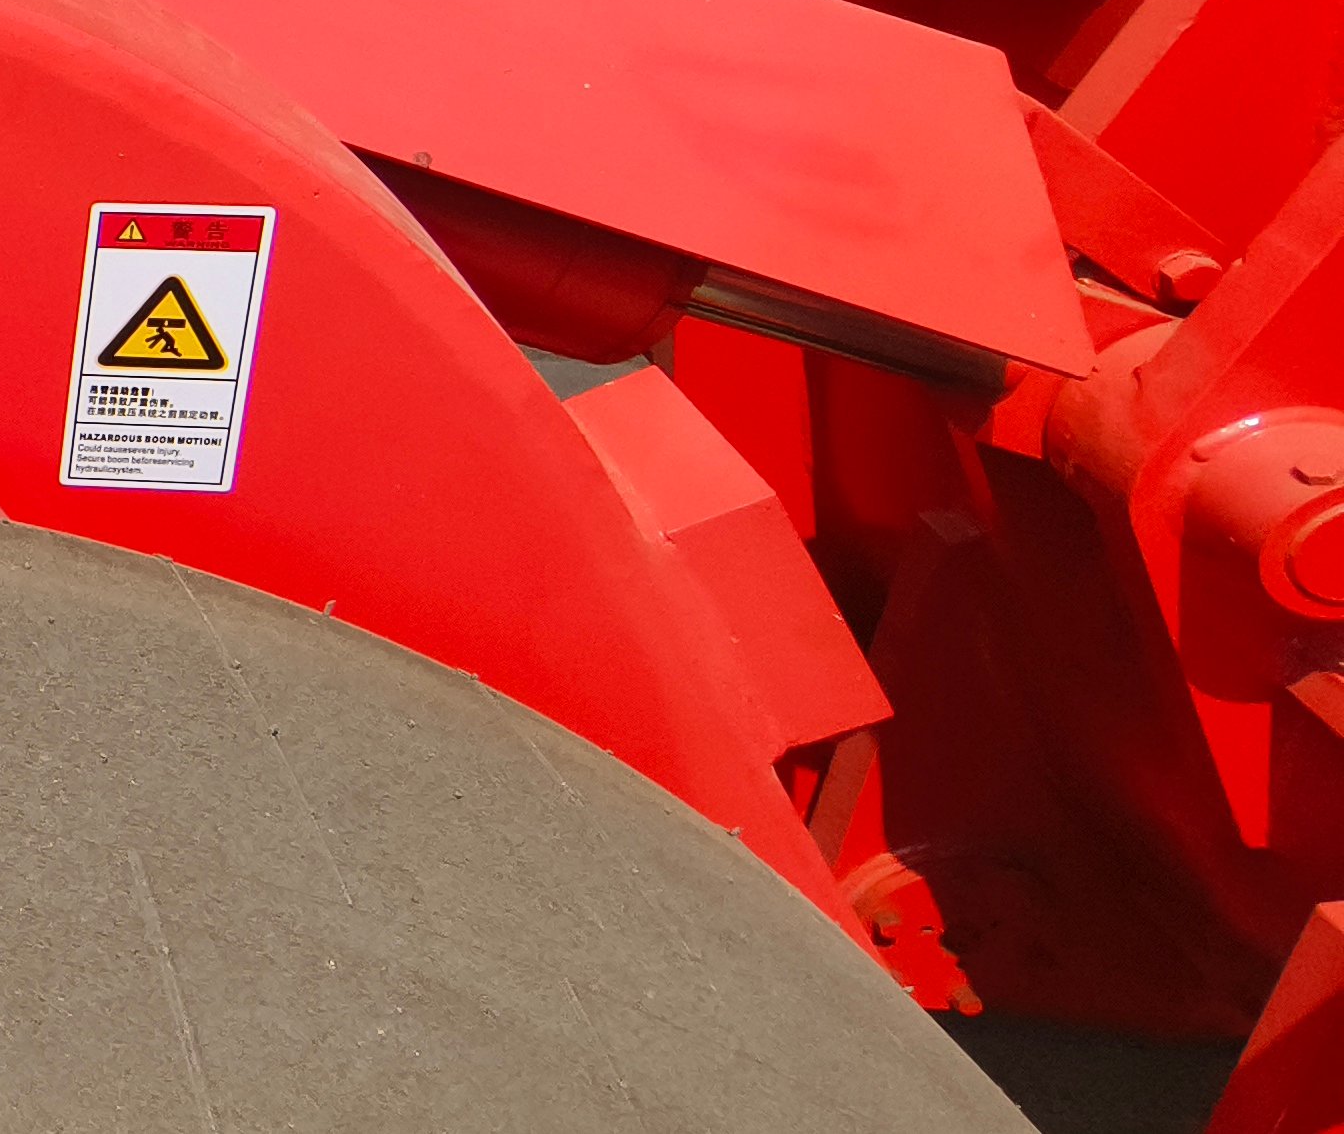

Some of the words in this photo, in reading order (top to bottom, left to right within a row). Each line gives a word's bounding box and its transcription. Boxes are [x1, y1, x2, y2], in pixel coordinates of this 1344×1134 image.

[79, 432, 143, 443] HAZARDOUS
[145, 435, 174, 444] BOOM
[177, 436, 223, 446] MOTION!
[77, 443, 102, 453] Could
[77, 453, 105, 463] Secure
[107, 455, 129, 464] boom
